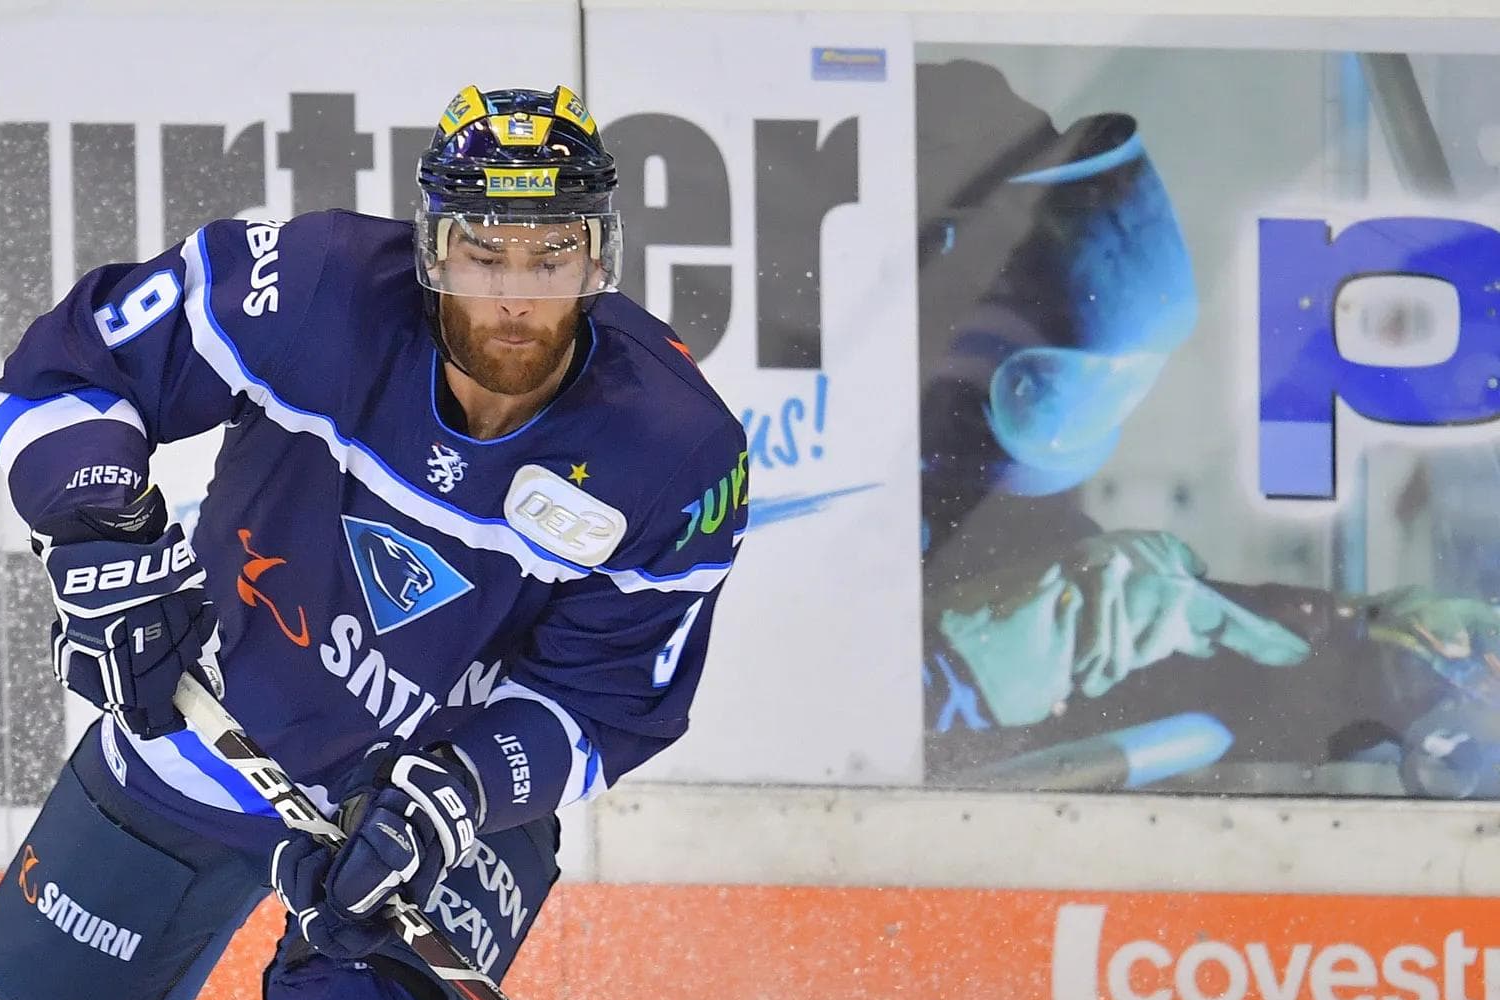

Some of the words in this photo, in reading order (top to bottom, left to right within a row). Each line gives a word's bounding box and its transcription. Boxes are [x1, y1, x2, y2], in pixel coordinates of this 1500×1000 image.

[490, 176, 553, 188] EDEKA
[243, 221, 284, 317] BUS
[93, 269, 182, 350] 9
[37, 882, 142, 961] SATURN
